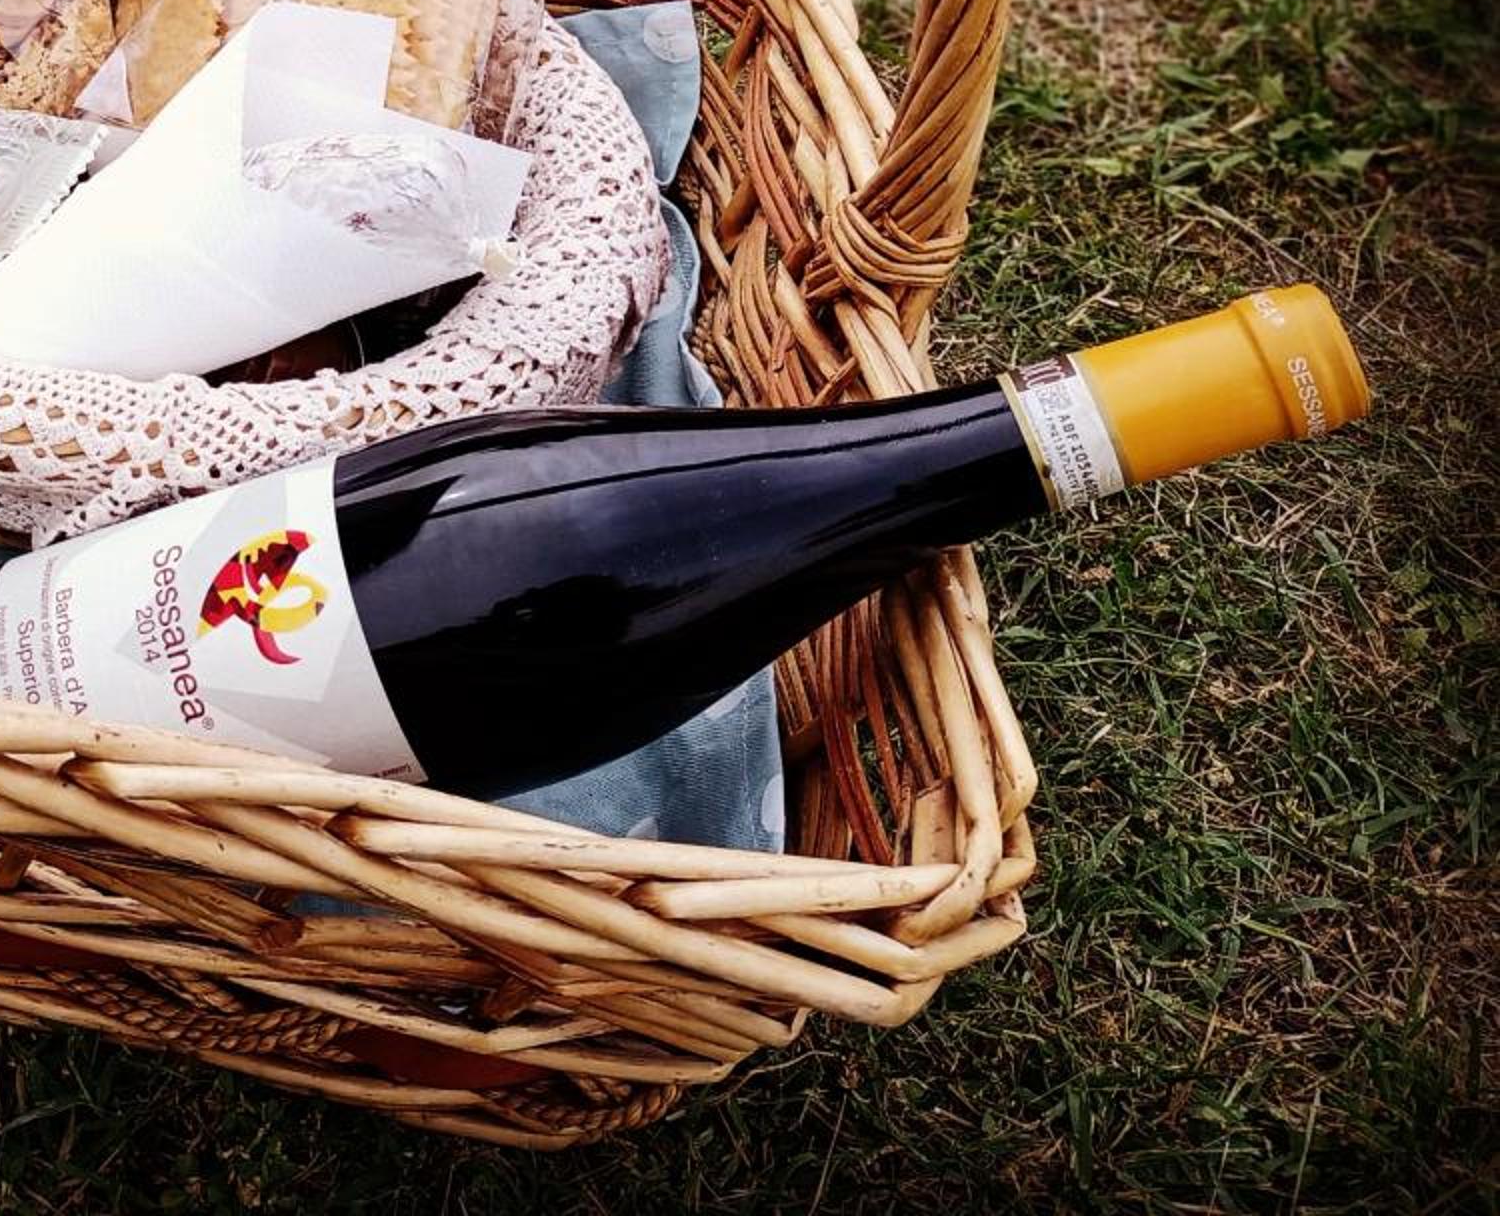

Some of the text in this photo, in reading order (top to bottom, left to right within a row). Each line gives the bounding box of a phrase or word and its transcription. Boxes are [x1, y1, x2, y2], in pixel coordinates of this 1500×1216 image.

[16, 619, 41, 706] Superio
[55, 587, 75, 671] Barbera
[65, 677, 88, 716] d'A
[134, 606, 162, 665] 2014
[152, 545, 206, 724] Sessanea
